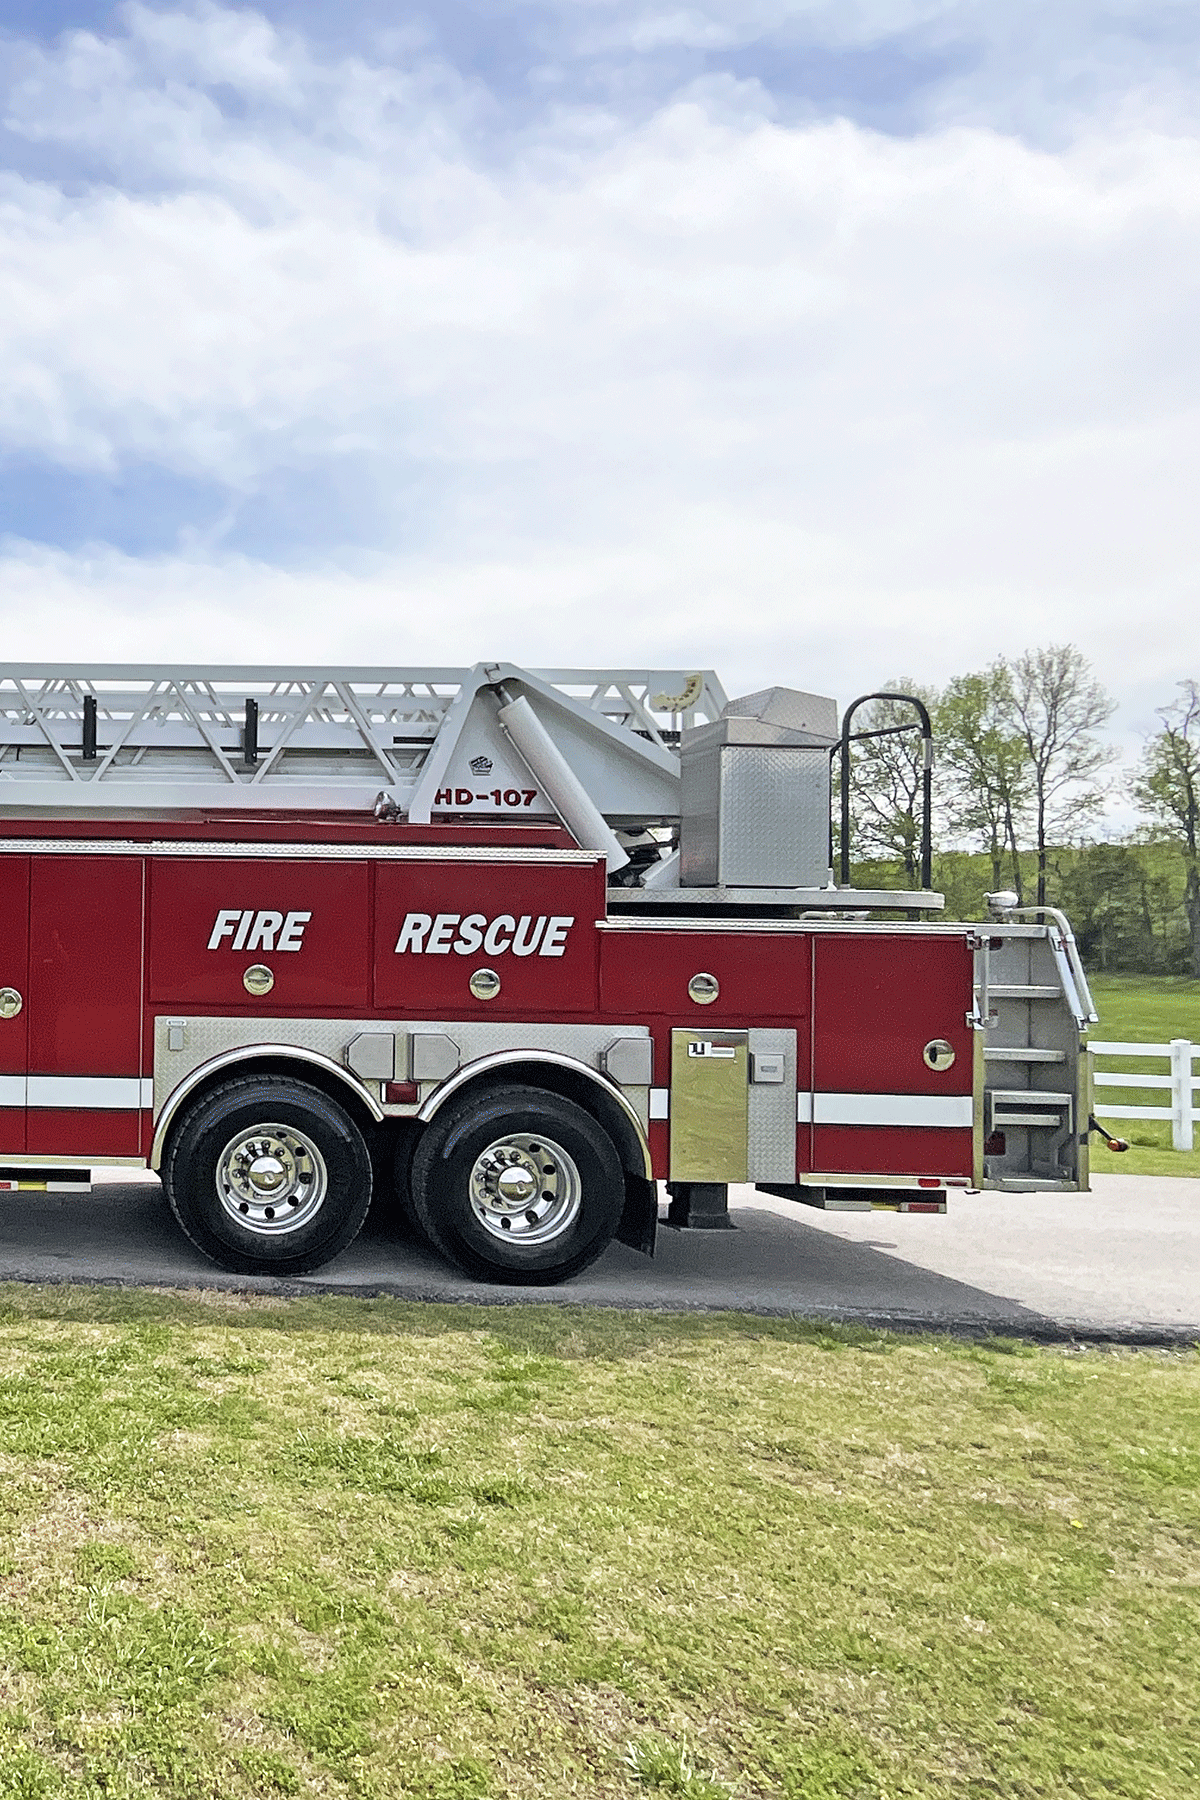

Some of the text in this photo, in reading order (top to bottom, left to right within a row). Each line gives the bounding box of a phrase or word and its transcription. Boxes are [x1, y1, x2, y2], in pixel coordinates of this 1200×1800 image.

[434, 788, 537, 806] HD-107
[207, 910, 575, 957] FIRE RESCUE
